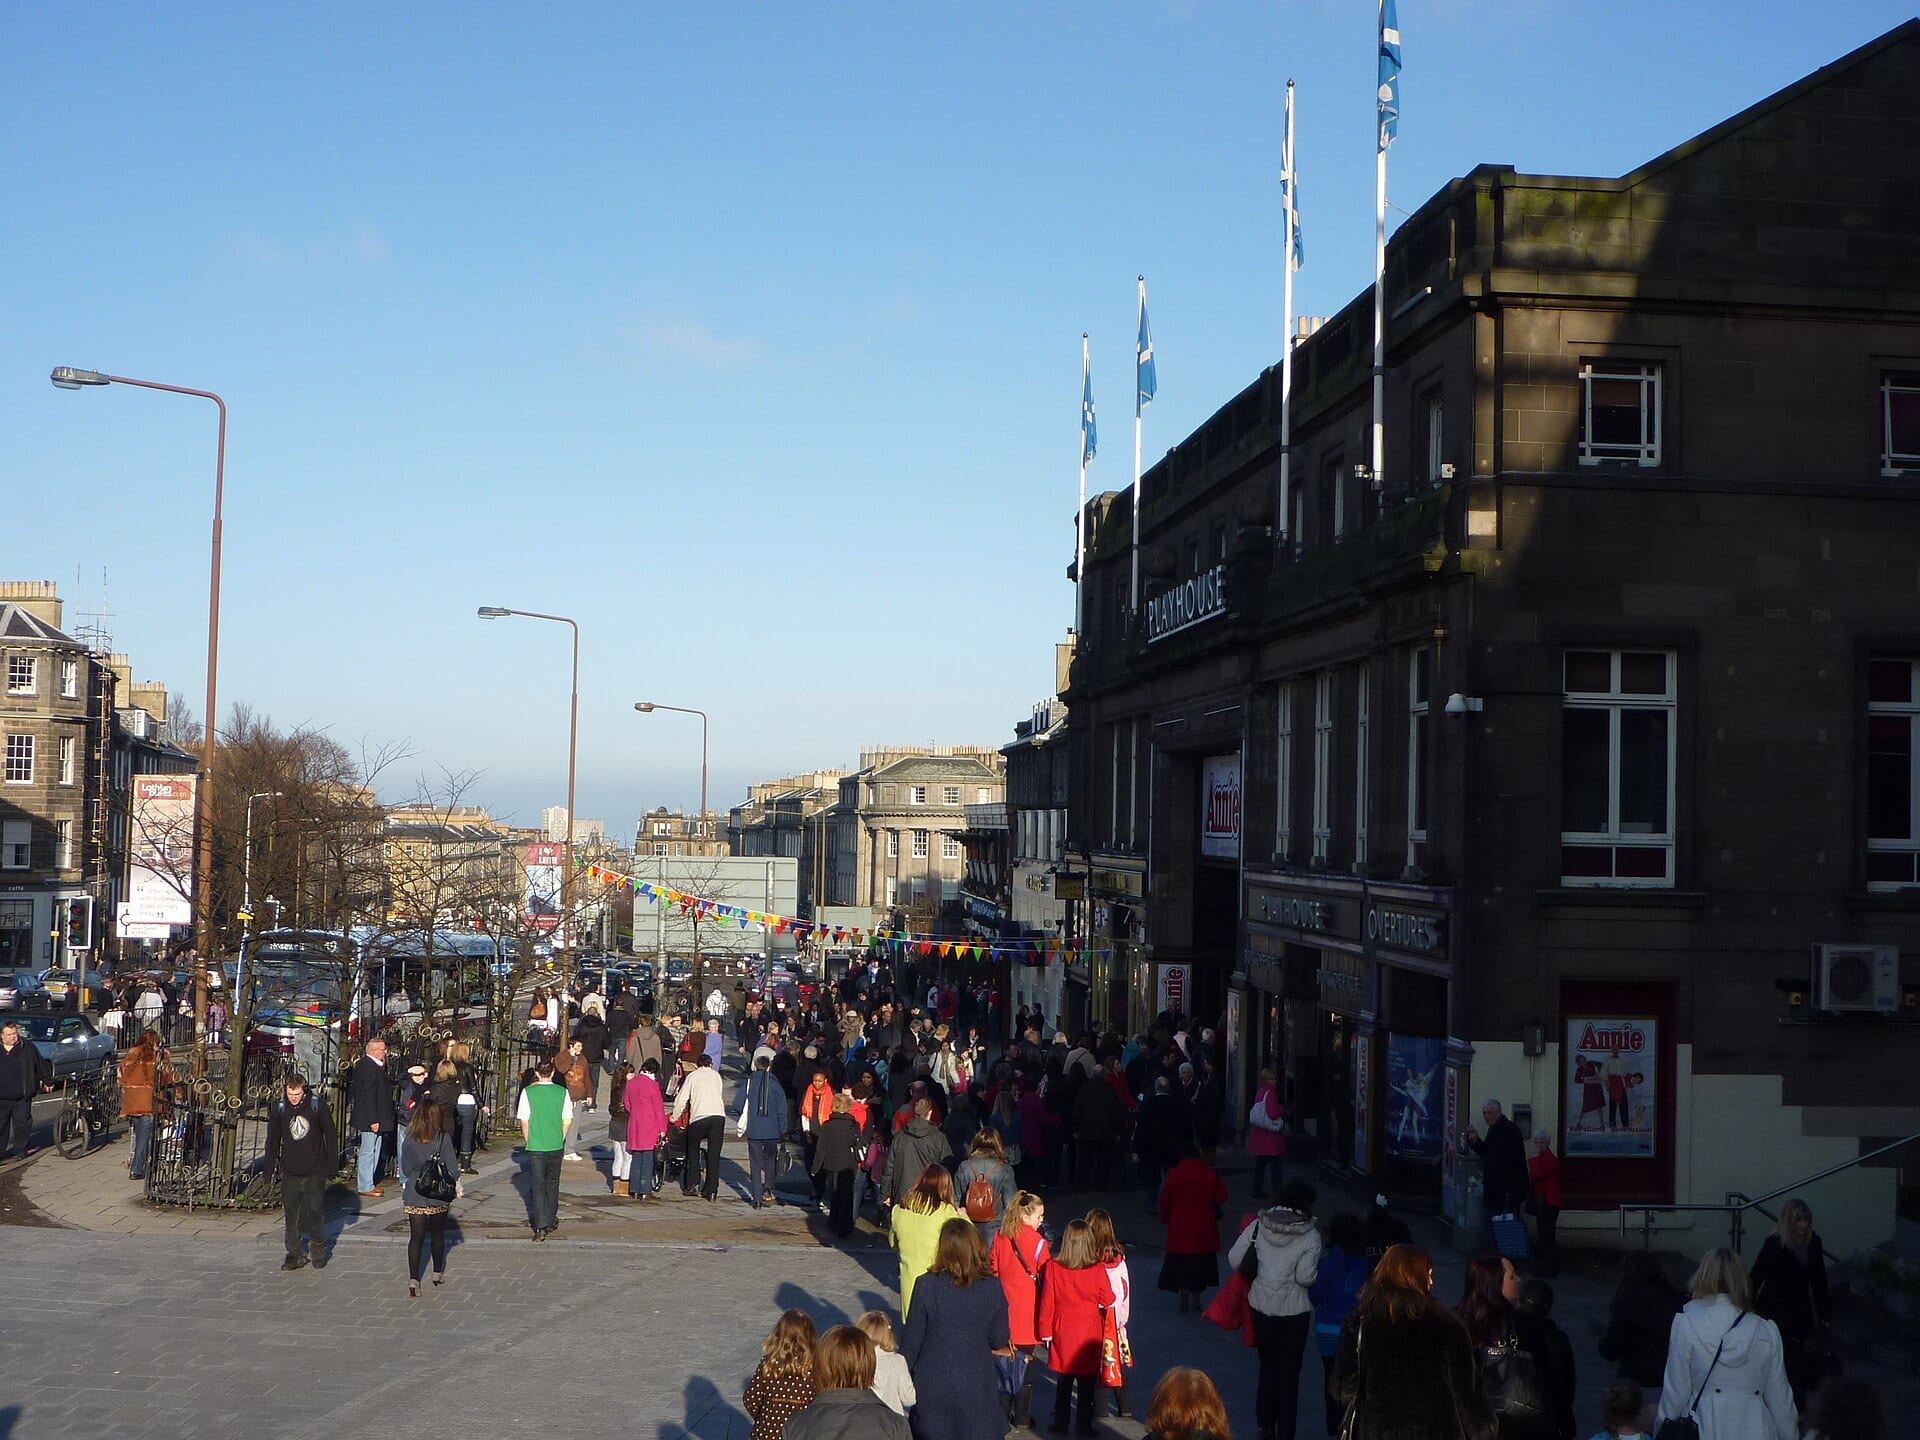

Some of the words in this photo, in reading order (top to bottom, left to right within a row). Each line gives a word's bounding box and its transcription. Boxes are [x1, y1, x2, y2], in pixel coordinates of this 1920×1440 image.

[1148, 564, 1226, 637] PLAYHOUSE
[1205, 772, 1240, 837] Annie
[1368, 909, 1437, 951] OVERTURES
[1163, 967, 1185, 1014] nnie
[1577, 1023, 1645, 1052] Annie
